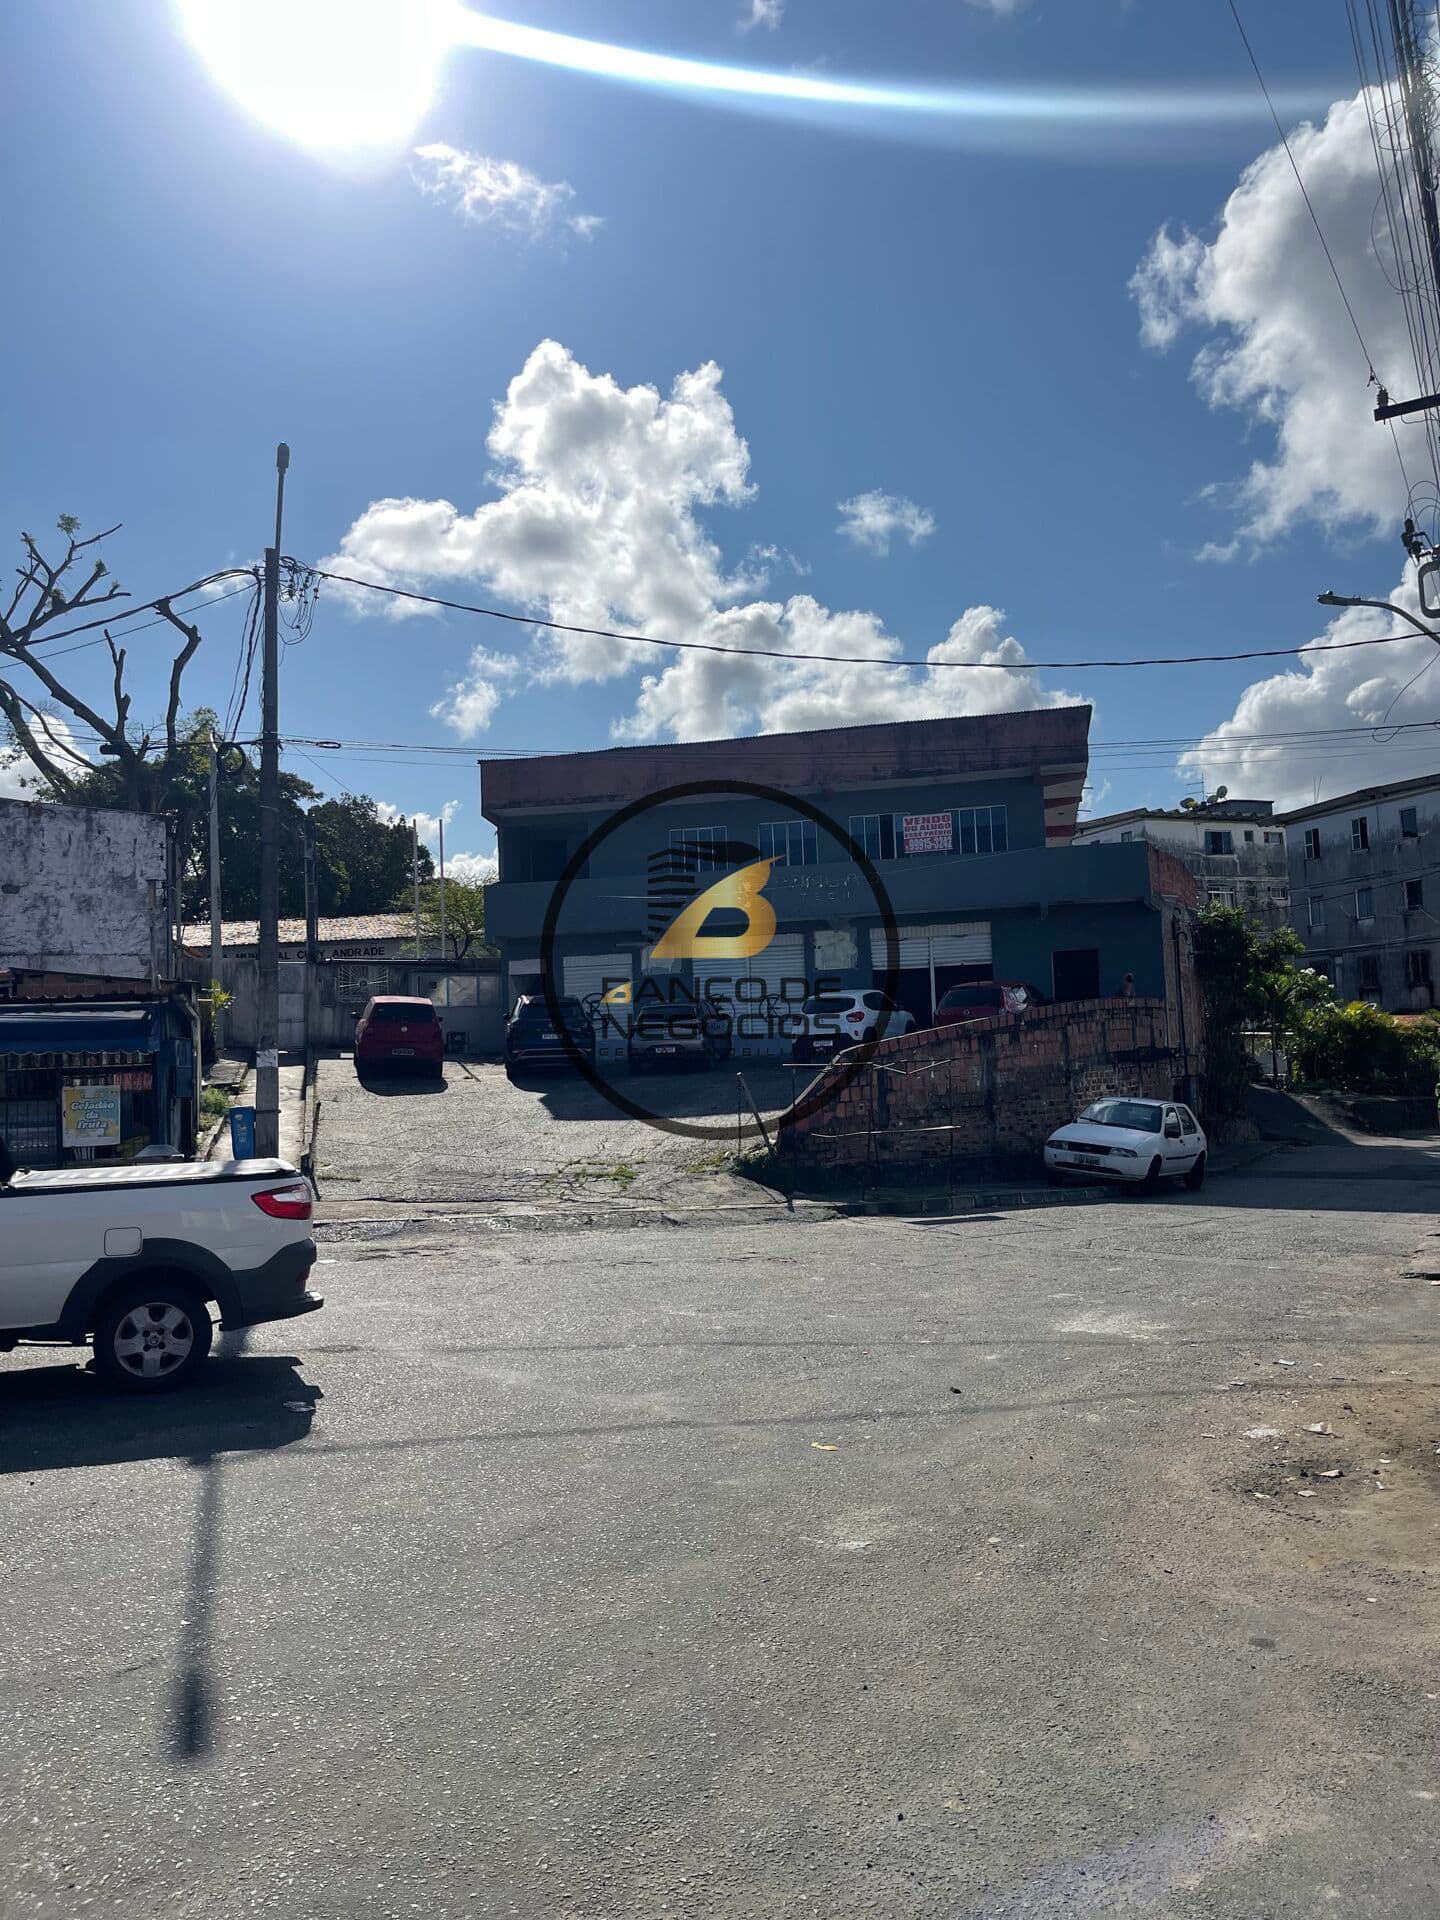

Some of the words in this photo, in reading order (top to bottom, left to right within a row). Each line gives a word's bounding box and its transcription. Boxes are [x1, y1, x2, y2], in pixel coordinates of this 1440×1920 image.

[905, 815, 950, 825] VENDO
[920, 822, 951, 831] ALUGO
[332, 947, 385, 957] ANDRADE
